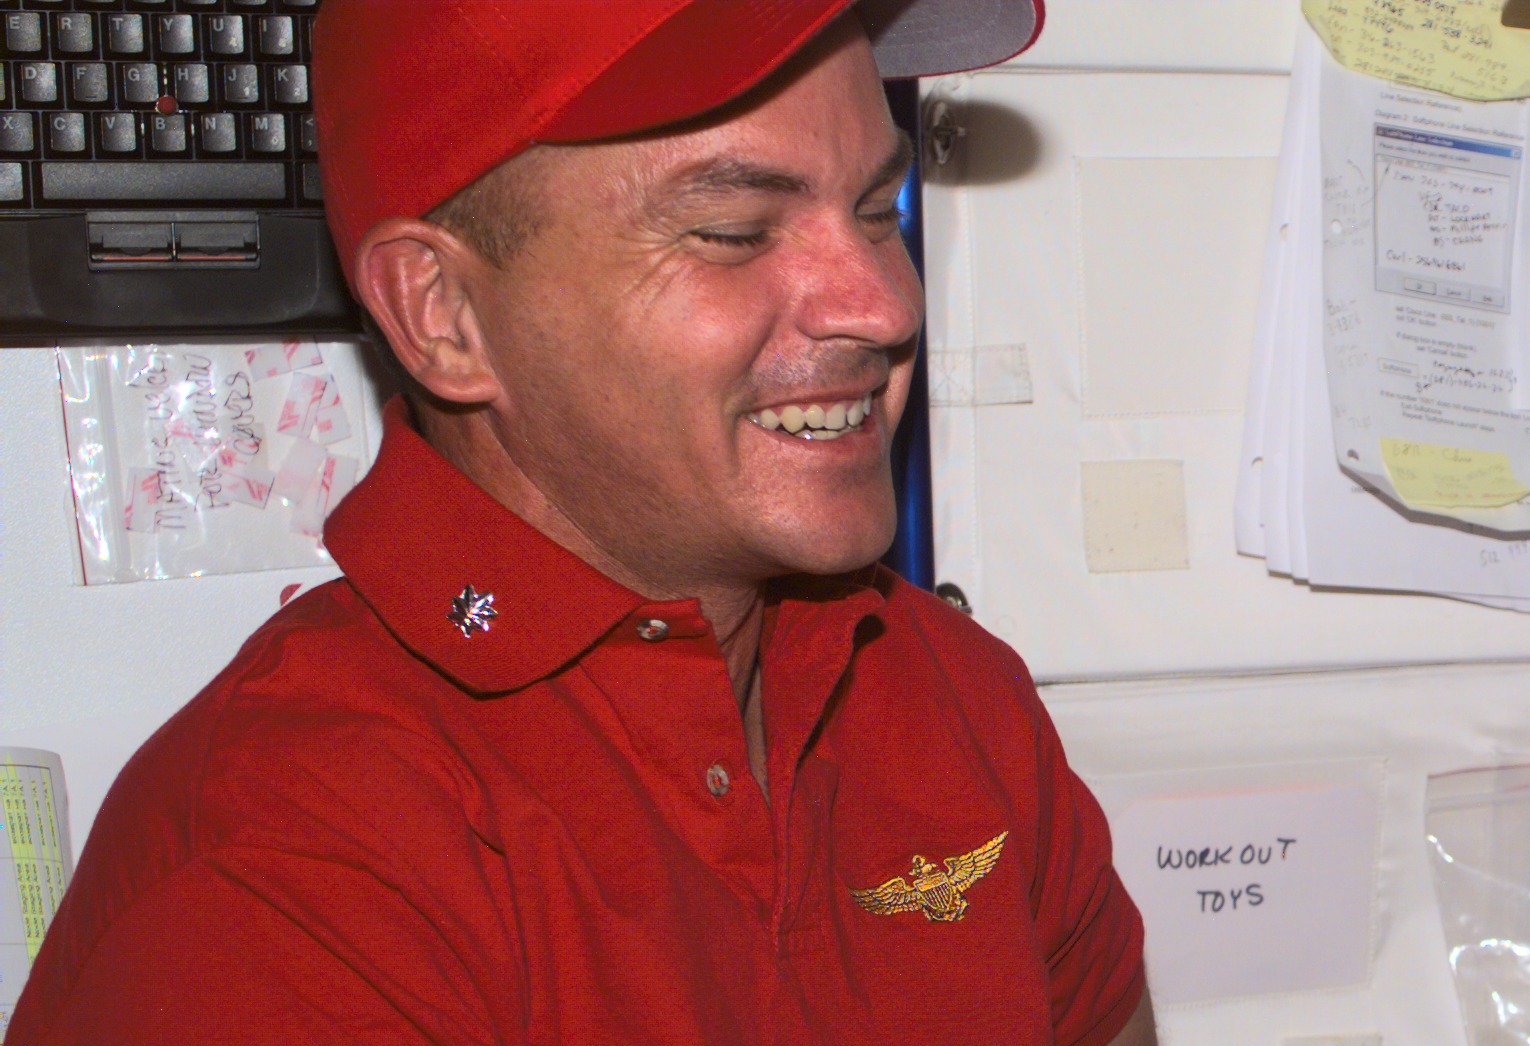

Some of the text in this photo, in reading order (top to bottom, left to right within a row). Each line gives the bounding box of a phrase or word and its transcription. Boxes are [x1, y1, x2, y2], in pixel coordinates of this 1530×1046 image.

[9, 16, 20, 30] E
[61, 17, 72, 30] R
[111, 17, 124, 31] T
[163, 18, 174, 31] Y
[212, 18, 225, 32] U
[25, 67, 38, 80] D
[76, 67, 86, 81] F
[128, 68, 141, 82] G
[178, 68, 190, 81] H
[228, 69, 237, 82] J
[278, 69, 289, 82] K
[3, 117, 14, 130] X
[53, 117, 66, 131] C
[104, 117, 116, 130] V
[156, 118, 166, 131] B
[205, 118, 217, 131] N
[254, 118, 269, 131] M
[1157, 838, 1297, 869] WORKOUT
[1197, 883, 1265, 913] TOYS
